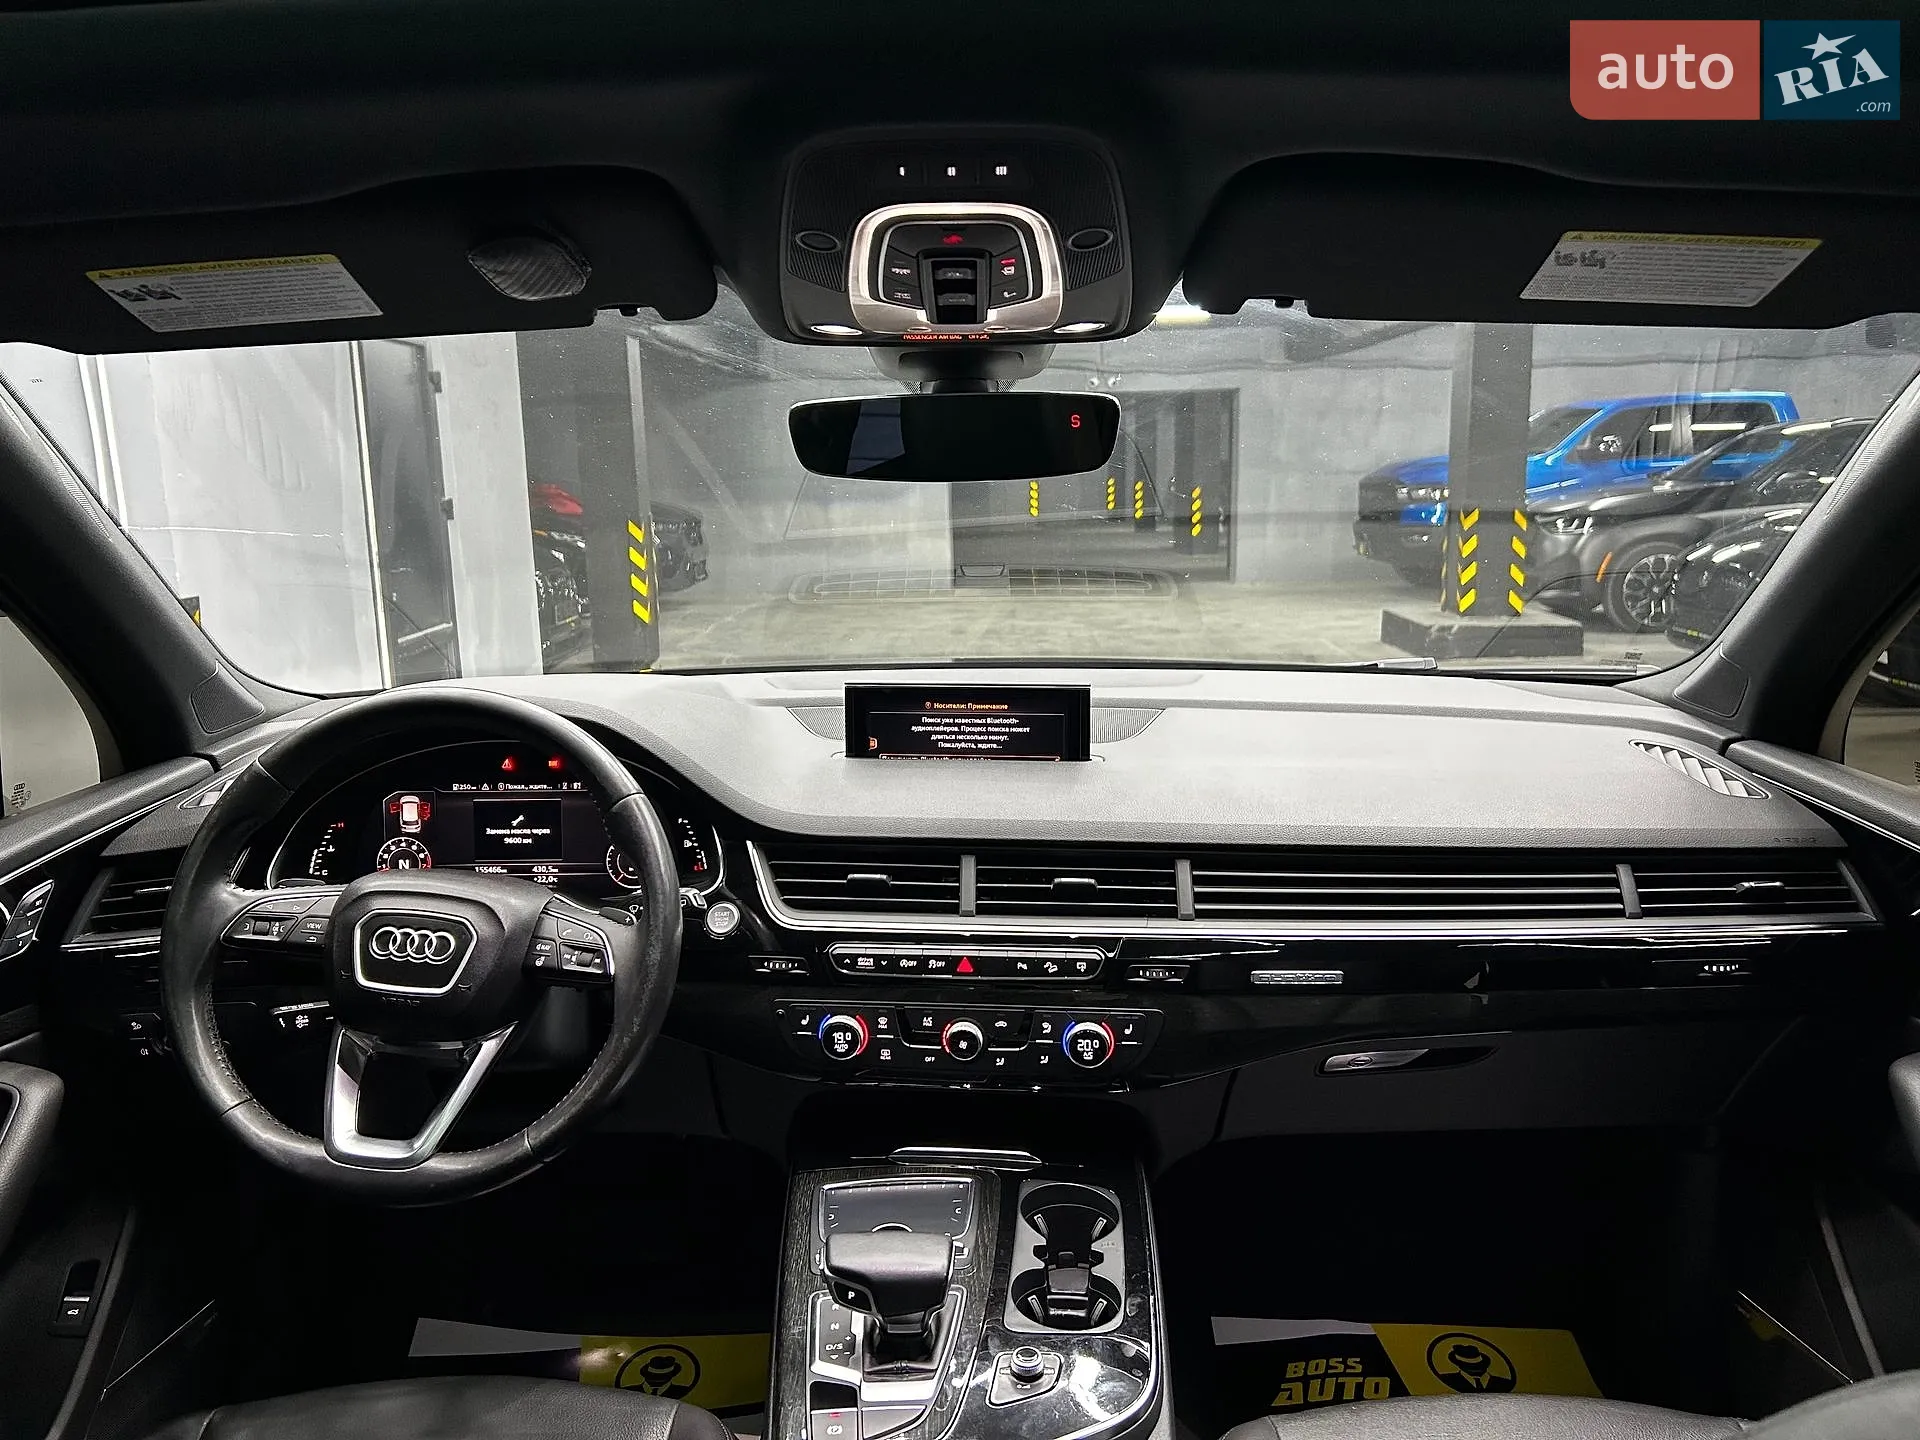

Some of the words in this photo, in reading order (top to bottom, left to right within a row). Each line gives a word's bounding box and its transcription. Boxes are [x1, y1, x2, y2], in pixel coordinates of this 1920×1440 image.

[1071, 414, 1081, 428] S
[960, 725, 987, 733] Процесс
[503, 836, 522, 844] 9600
[398, 859, 410, 870] N
[848, 1291, 855, 1299] P
[830, 1322, 840, 1330] N
[825, 1343, 843, 1351] D/S
[1285, 1357, 1362, 1377] BOSS
[1271, 1376, 1390, 1406] AUTO
